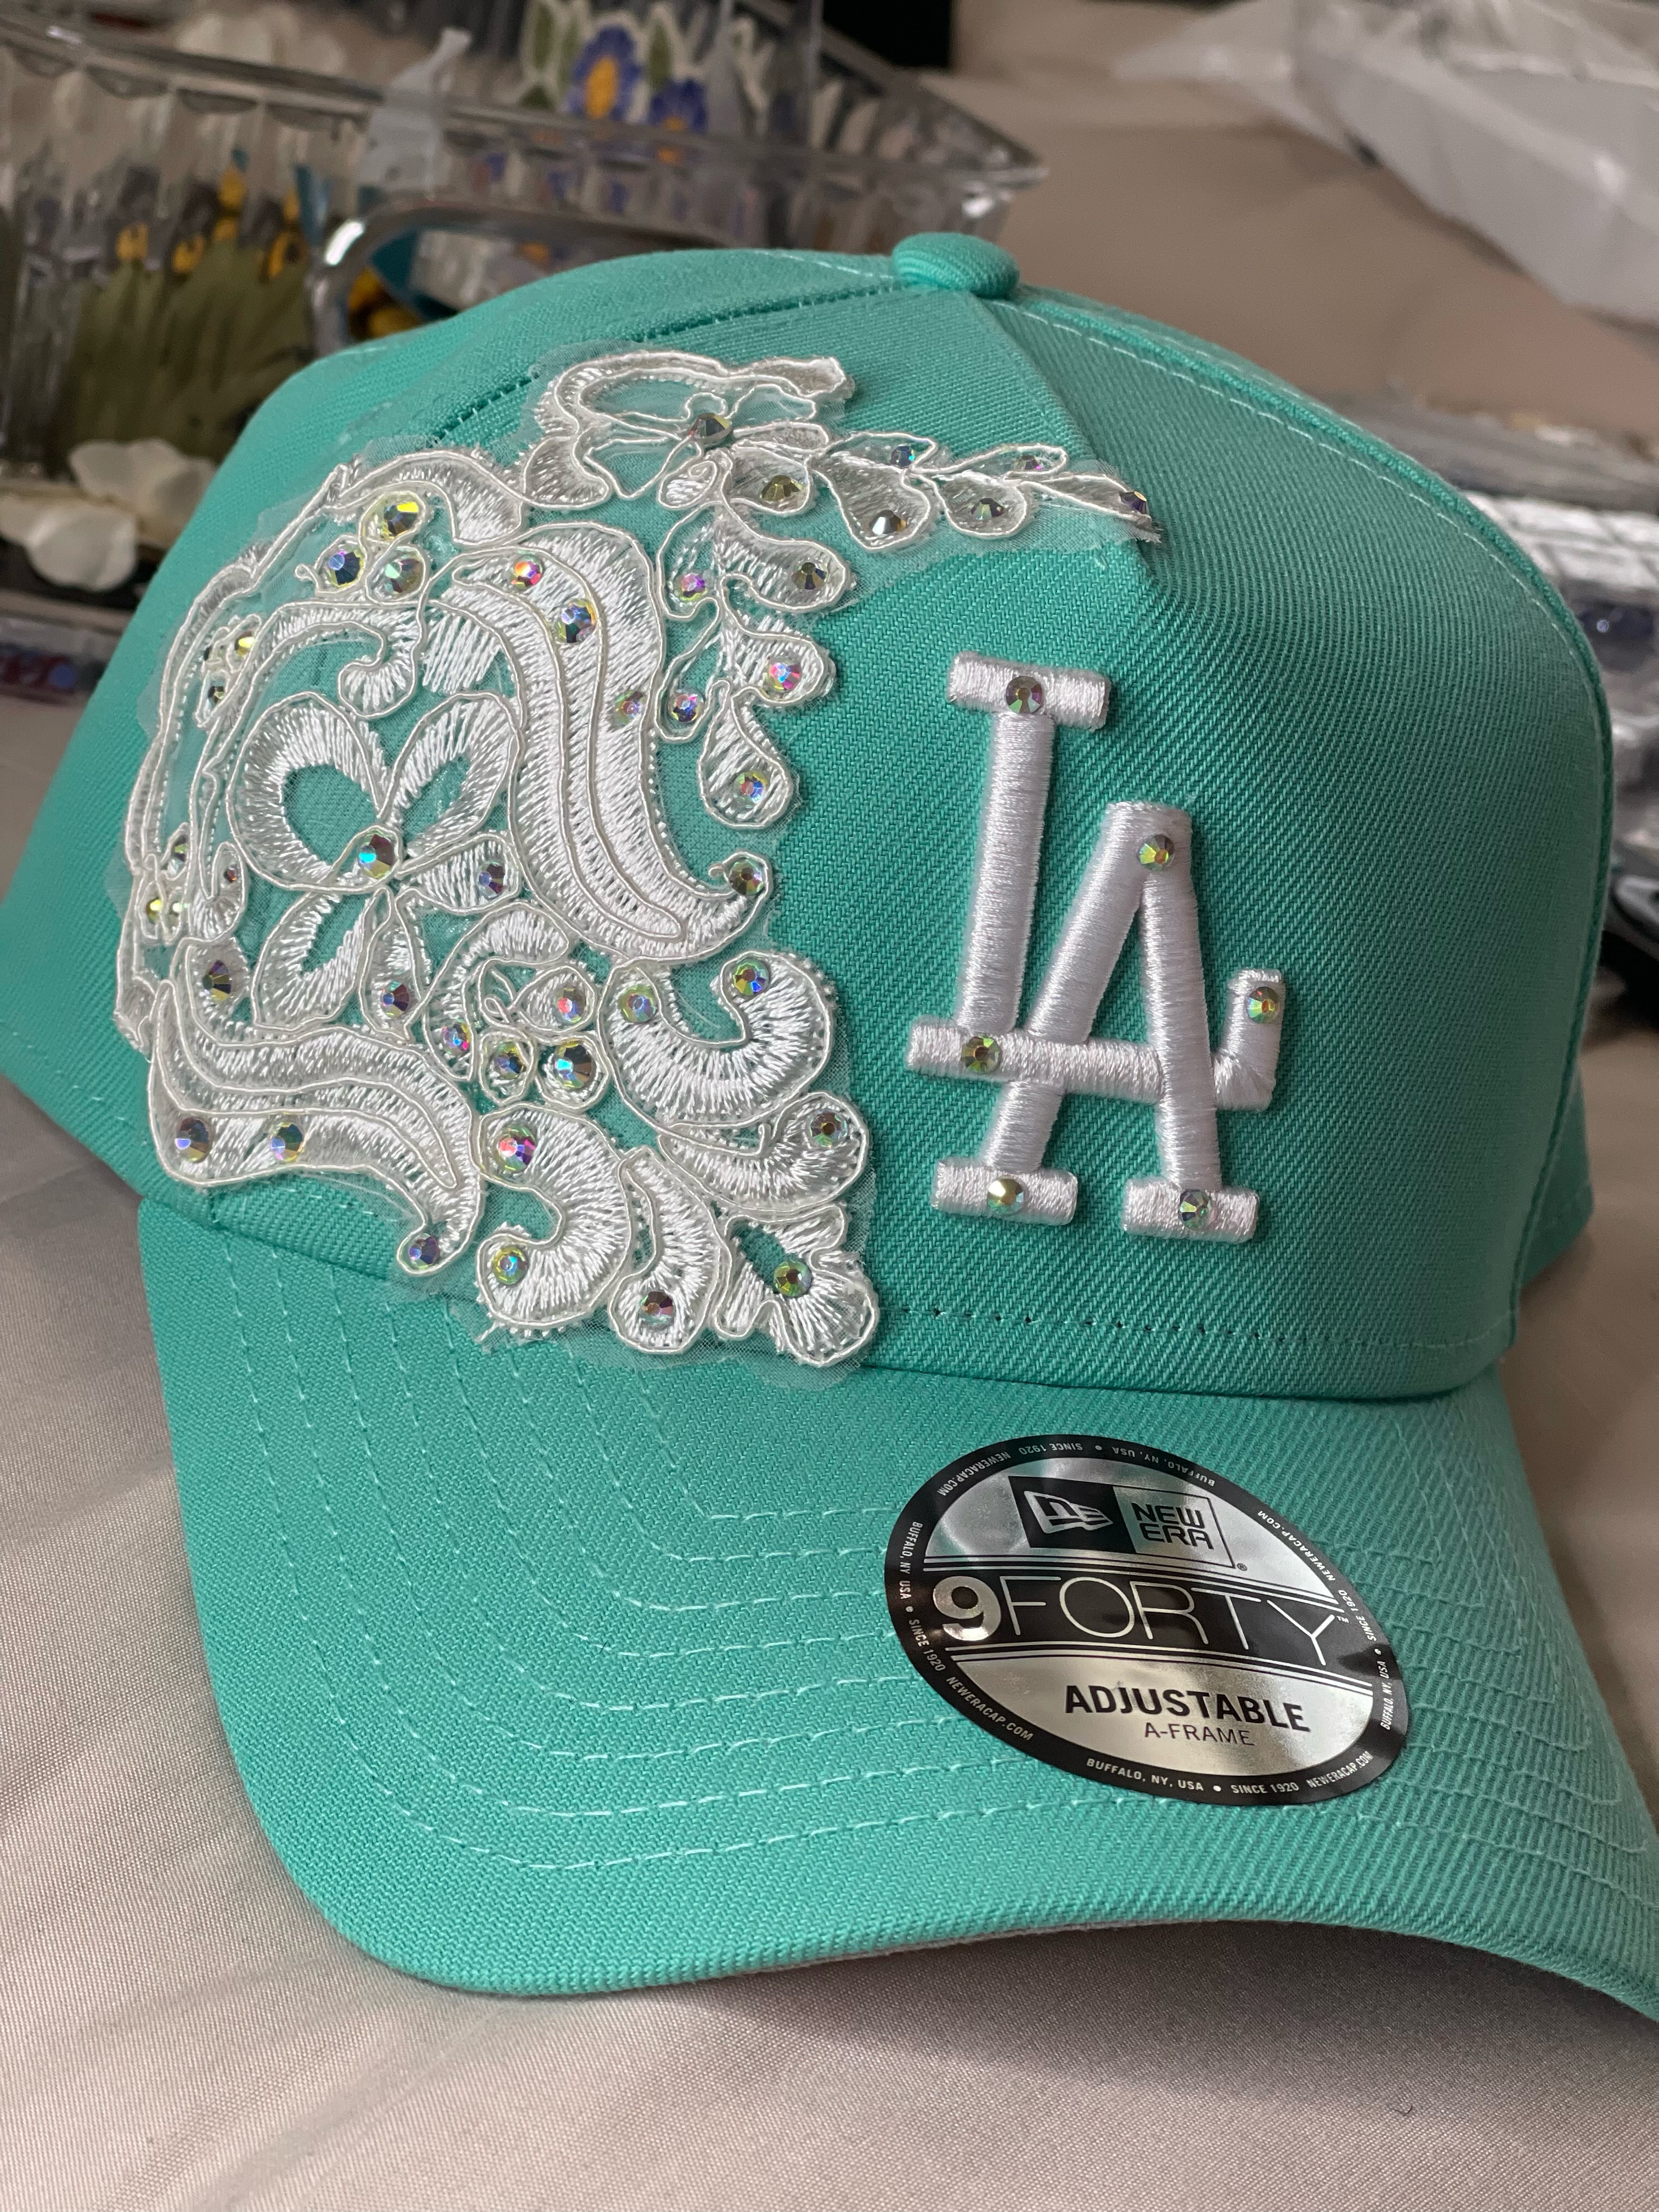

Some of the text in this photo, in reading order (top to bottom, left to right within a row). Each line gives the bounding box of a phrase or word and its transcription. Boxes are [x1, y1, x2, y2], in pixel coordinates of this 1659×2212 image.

[905, 651, 1285, 1244] LA
[1018, 1442, 1083, 1455] SINCE 1920
[1112, 1446, 1136, 1458] USA
[936, 1451, 1012, 1497] NEWERACAP.COM
[1131, 1502, 1206, 1530] NEW
[899, 1521, 923, 1559] BUFFALO,
[1138, 1523, 1214, 1550] ERA
[1257, 1510, 1336, 1582] NEWERACAP.COM
[899, 1580, 912, 1600] USA
[932, 1575, 1336, 1667] 9FORTY
[1338, 1589, 1377, 1642] SINCE 1920
[909, 1618, 946, 1672] SINCE 1920
[1376, 1660, 1390, 1679] USA
[946, 1676, 1034, 1741] NEWERACAP.COM
[1065, 1684, 1312, 1733] ADJUSTABLE
[1144, 1722, 1256, 1746] A-FRAME
[1177, 1780, 1204, 1791] USA
[1231, 1782, 1300, 1794] SINCE 1920
[1306, 1751, 1374, 1789] NEWERACAP.COM
